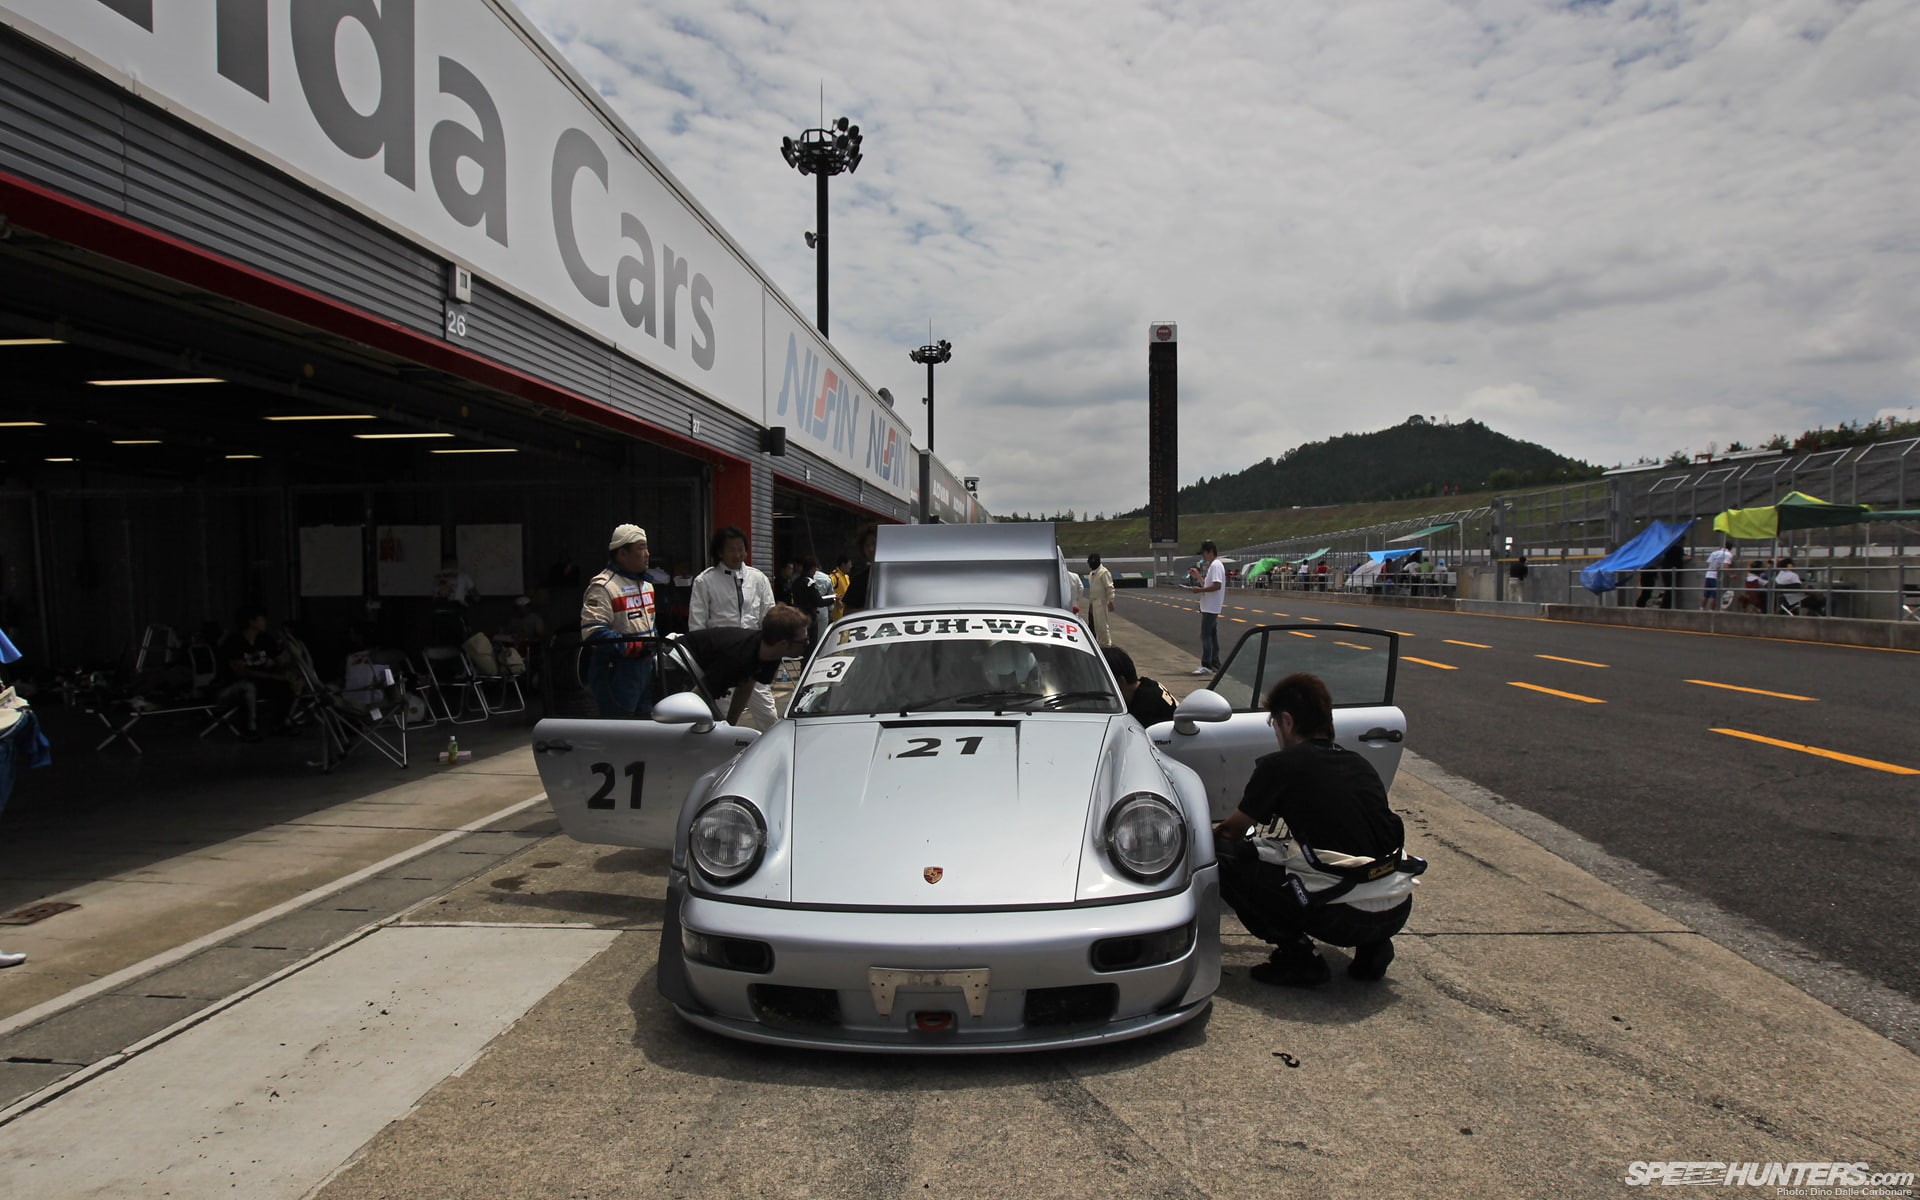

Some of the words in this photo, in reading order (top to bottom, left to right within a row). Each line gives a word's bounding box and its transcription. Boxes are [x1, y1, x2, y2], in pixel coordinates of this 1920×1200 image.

[551, 127, 716, 372] Cars
[447, 310, 466, 336] 26
[826, 661, 846, 679] 3
[896, 735, 984, 759] 21
[587, 761, 646, 810] 21
